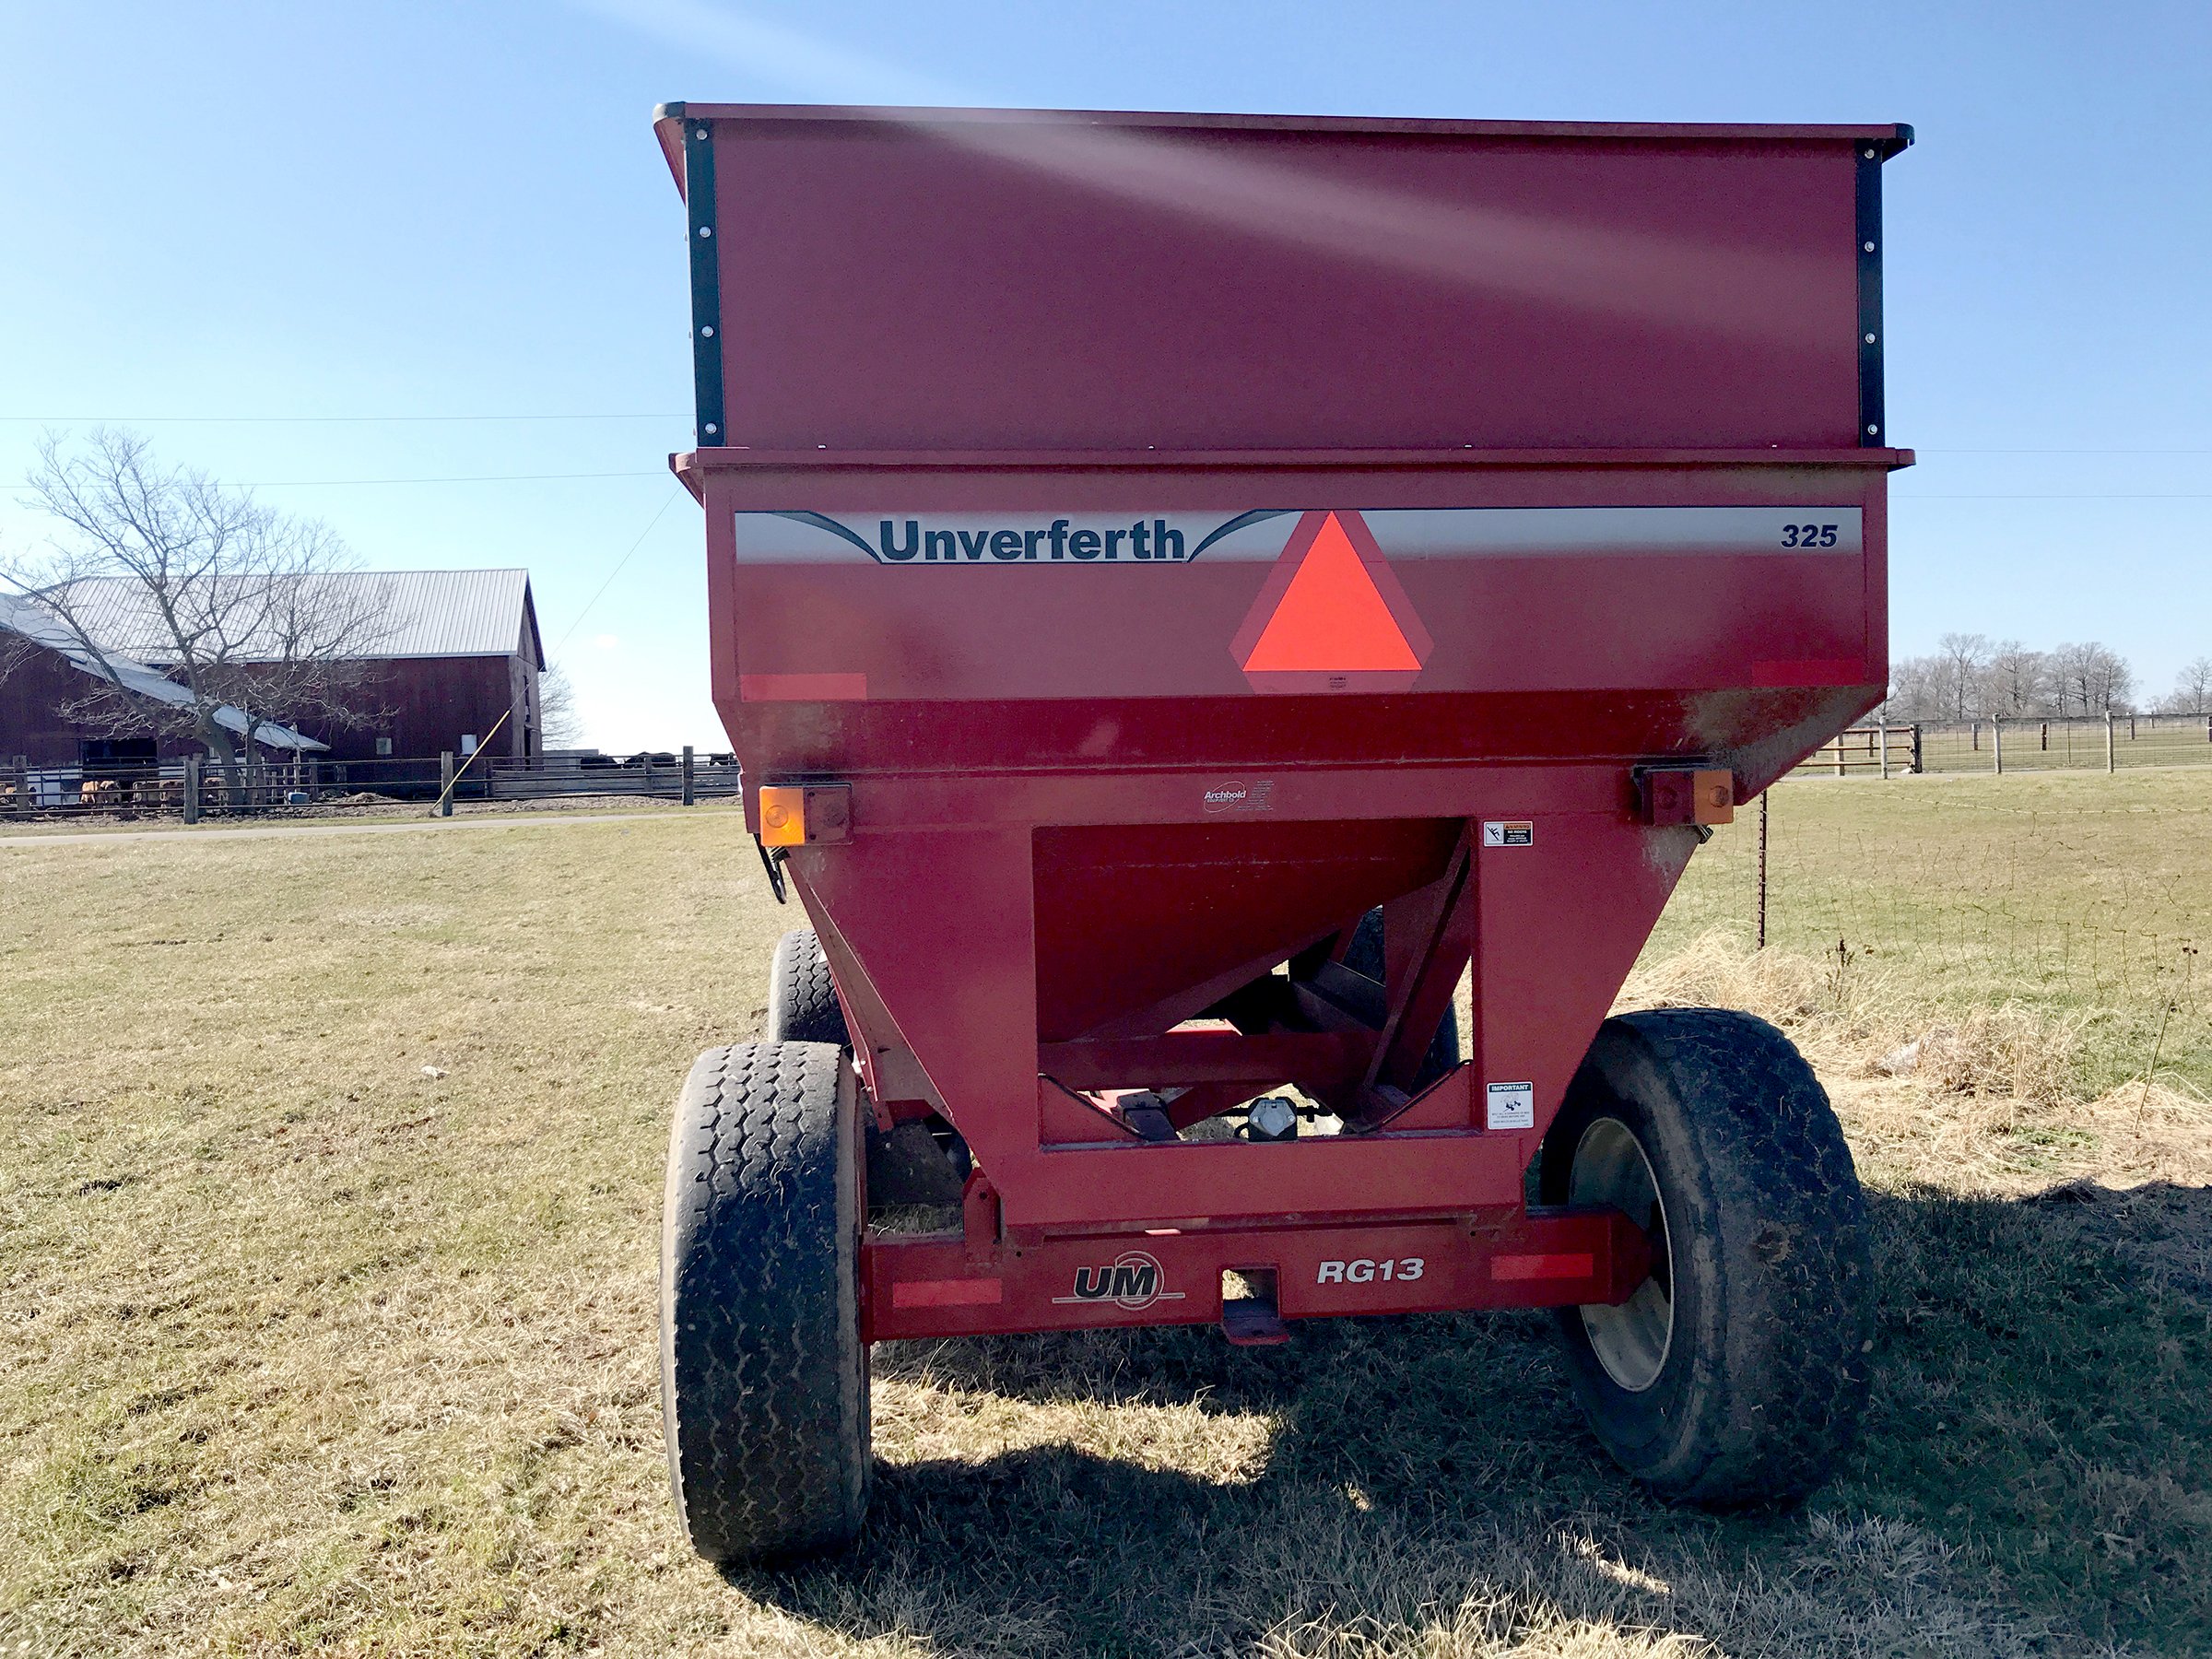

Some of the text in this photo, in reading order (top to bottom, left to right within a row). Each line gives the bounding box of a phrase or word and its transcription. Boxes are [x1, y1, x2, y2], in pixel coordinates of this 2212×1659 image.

[879, 520, 1184, 560] Unverferth
[1781, 524, 1838, 547] 325
[1204, 791, 1246, 799] Archbold
[1074, 1266, 1156, 1298] UM
[1317, 1258, 1425, 1284] RG13
